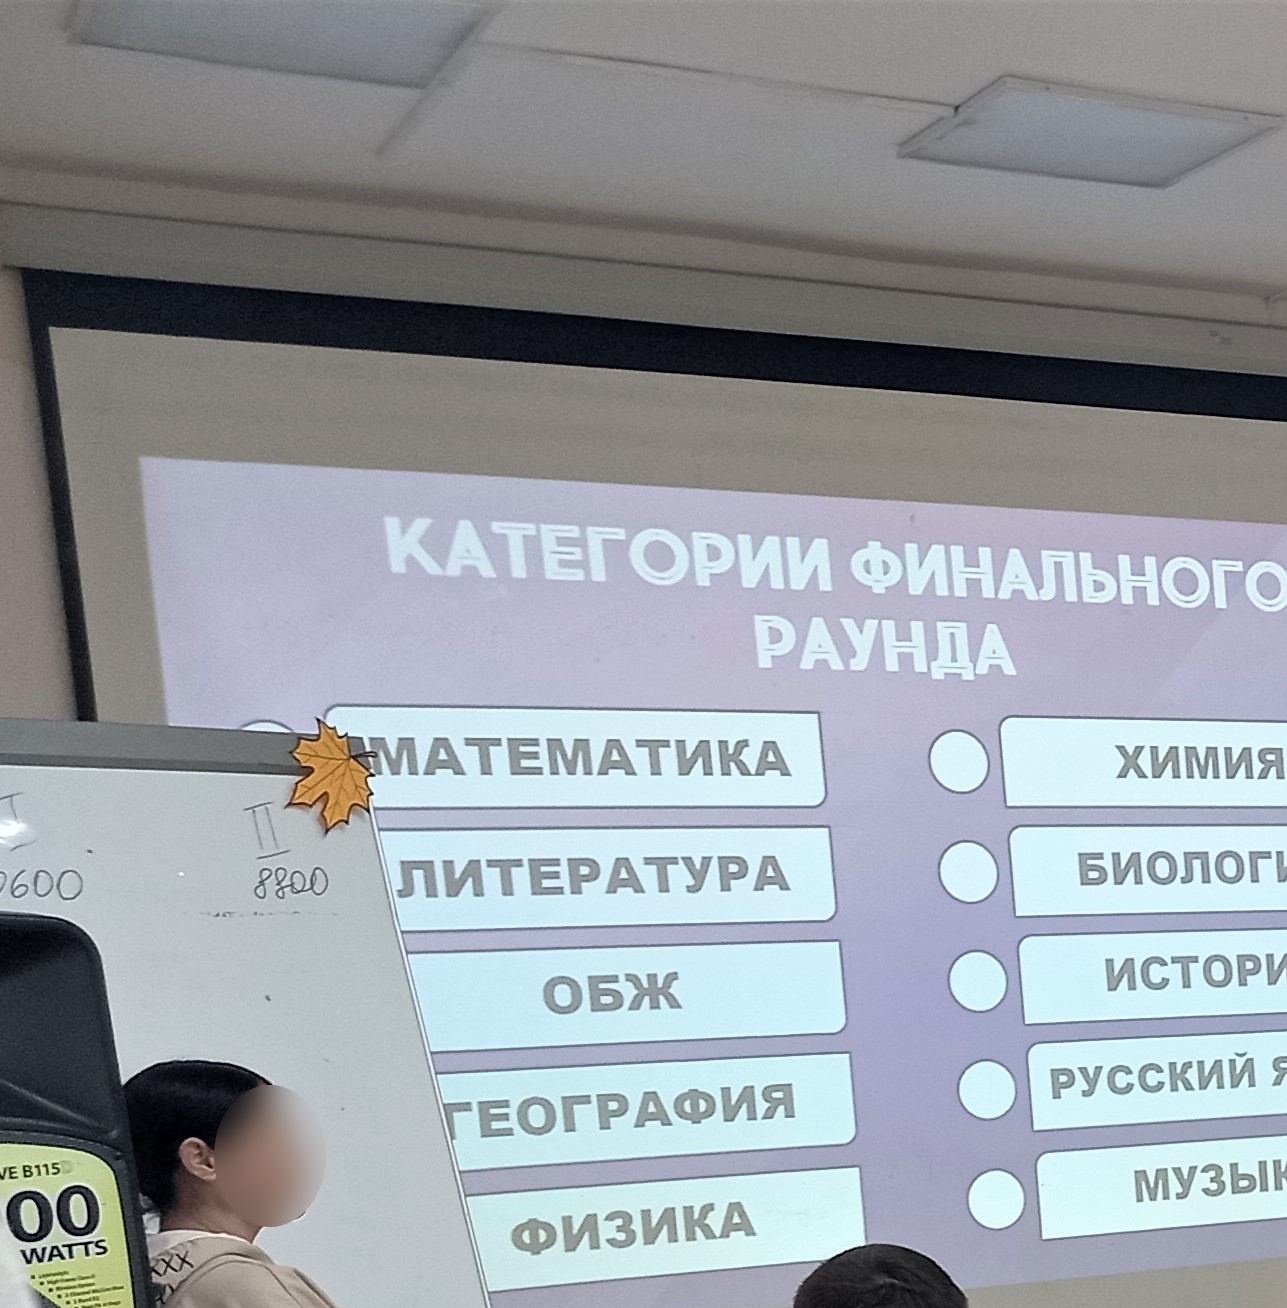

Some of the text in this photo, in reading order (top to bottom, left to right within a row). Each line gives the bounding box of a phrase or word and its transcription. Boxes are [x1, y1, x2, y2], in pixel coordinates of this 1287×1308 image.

[382, 515, 834, 592] КАТЕГОРИИ
[752, 613, 1018, 681] РАУНДА
[368, 736, 793, 777] МАТЕМАТИКА
[1115, 744, 1287, 781] ХИМИЯ
[253, 866, 329, 900] 8800
[396, 855, 792, 899] ЛИТЕРАТУРА
[542, 971, 683, 1015] ОБЖ
[1049, 1051, 1257, 1100] РУССКИЙ
[442, 1082, 797, 1141] ГЕОГРАФИЯ
[22, 1162, 61, 1178] B115
[5, 1184, 101, 1243] 00
[510, 1200, 757, 1256] ФИЗИКА
[20, 1239, 109, 1265] WATTS
